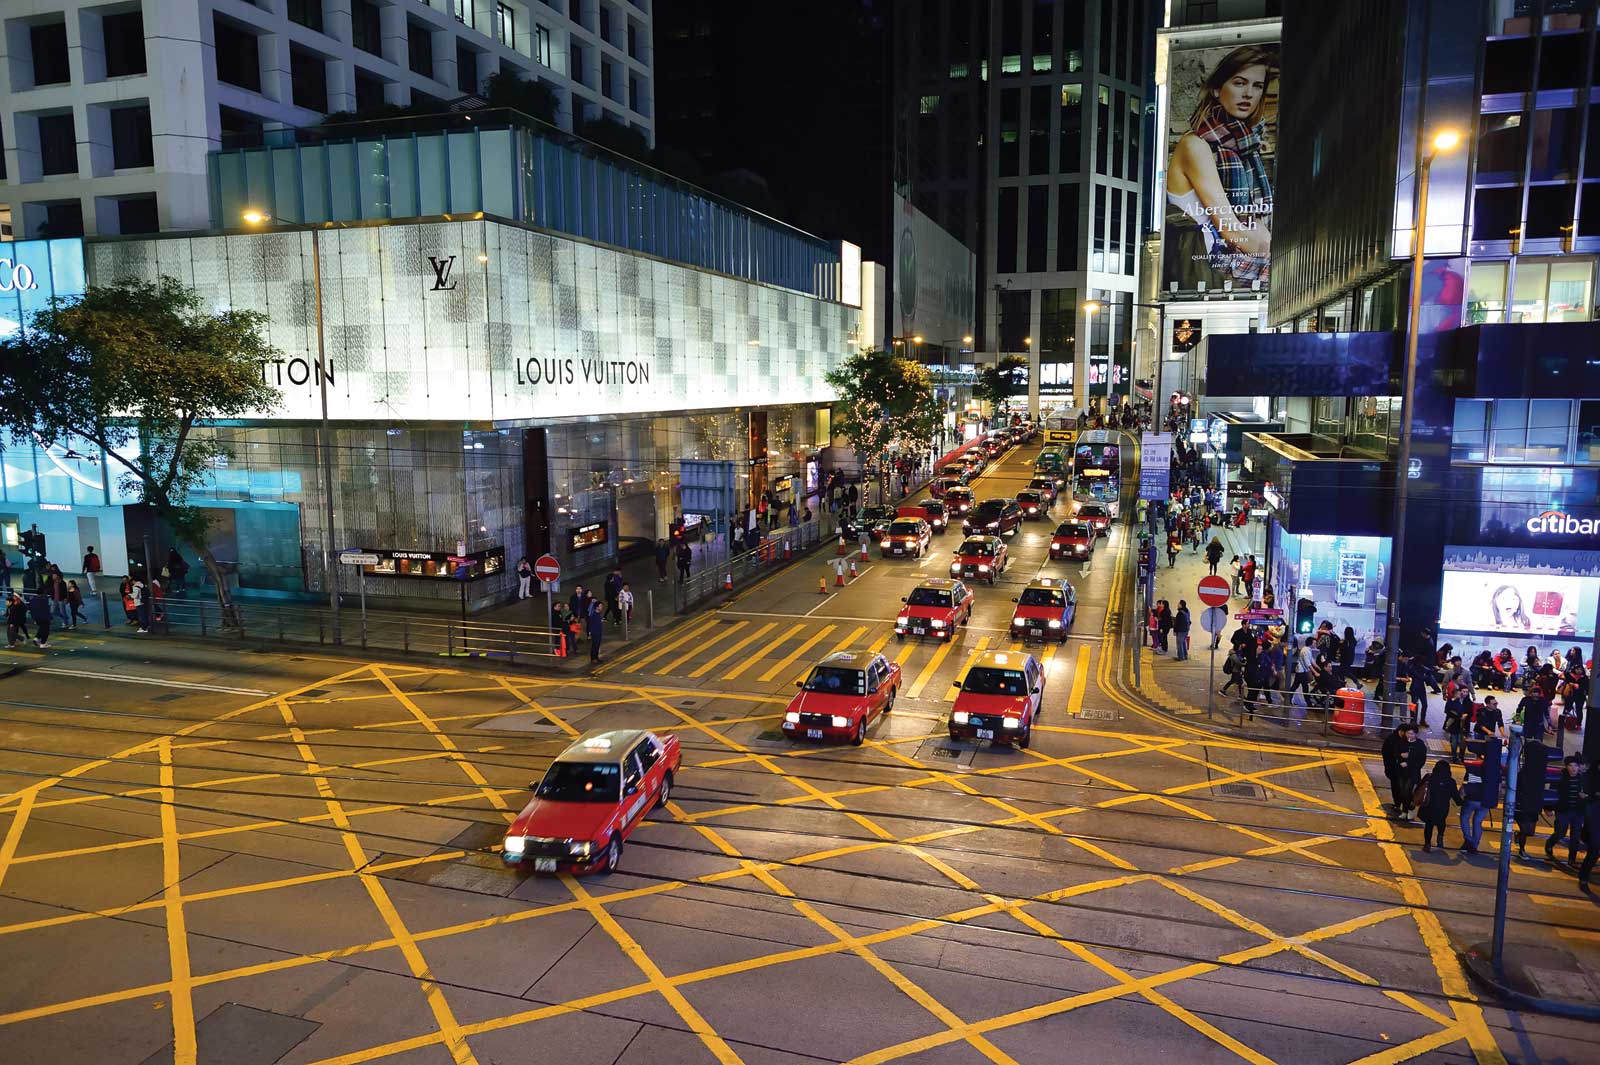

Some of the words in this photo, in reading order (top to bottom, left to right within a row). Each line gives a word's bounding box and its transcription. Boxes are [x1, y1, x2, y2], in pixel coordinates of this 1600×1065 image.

[1182, 197, 1274, 217] Abercrombi
[1201, 222, 1213, 233] &
[1217, 215, 1257, 232] Fitch
[1191, 253, 1217, 261] QUALITY
[260, 358, 335, 387] TTON
[516, 357, 574, 385] LOUIS
[581, 358, 650, 385] VUITTON
